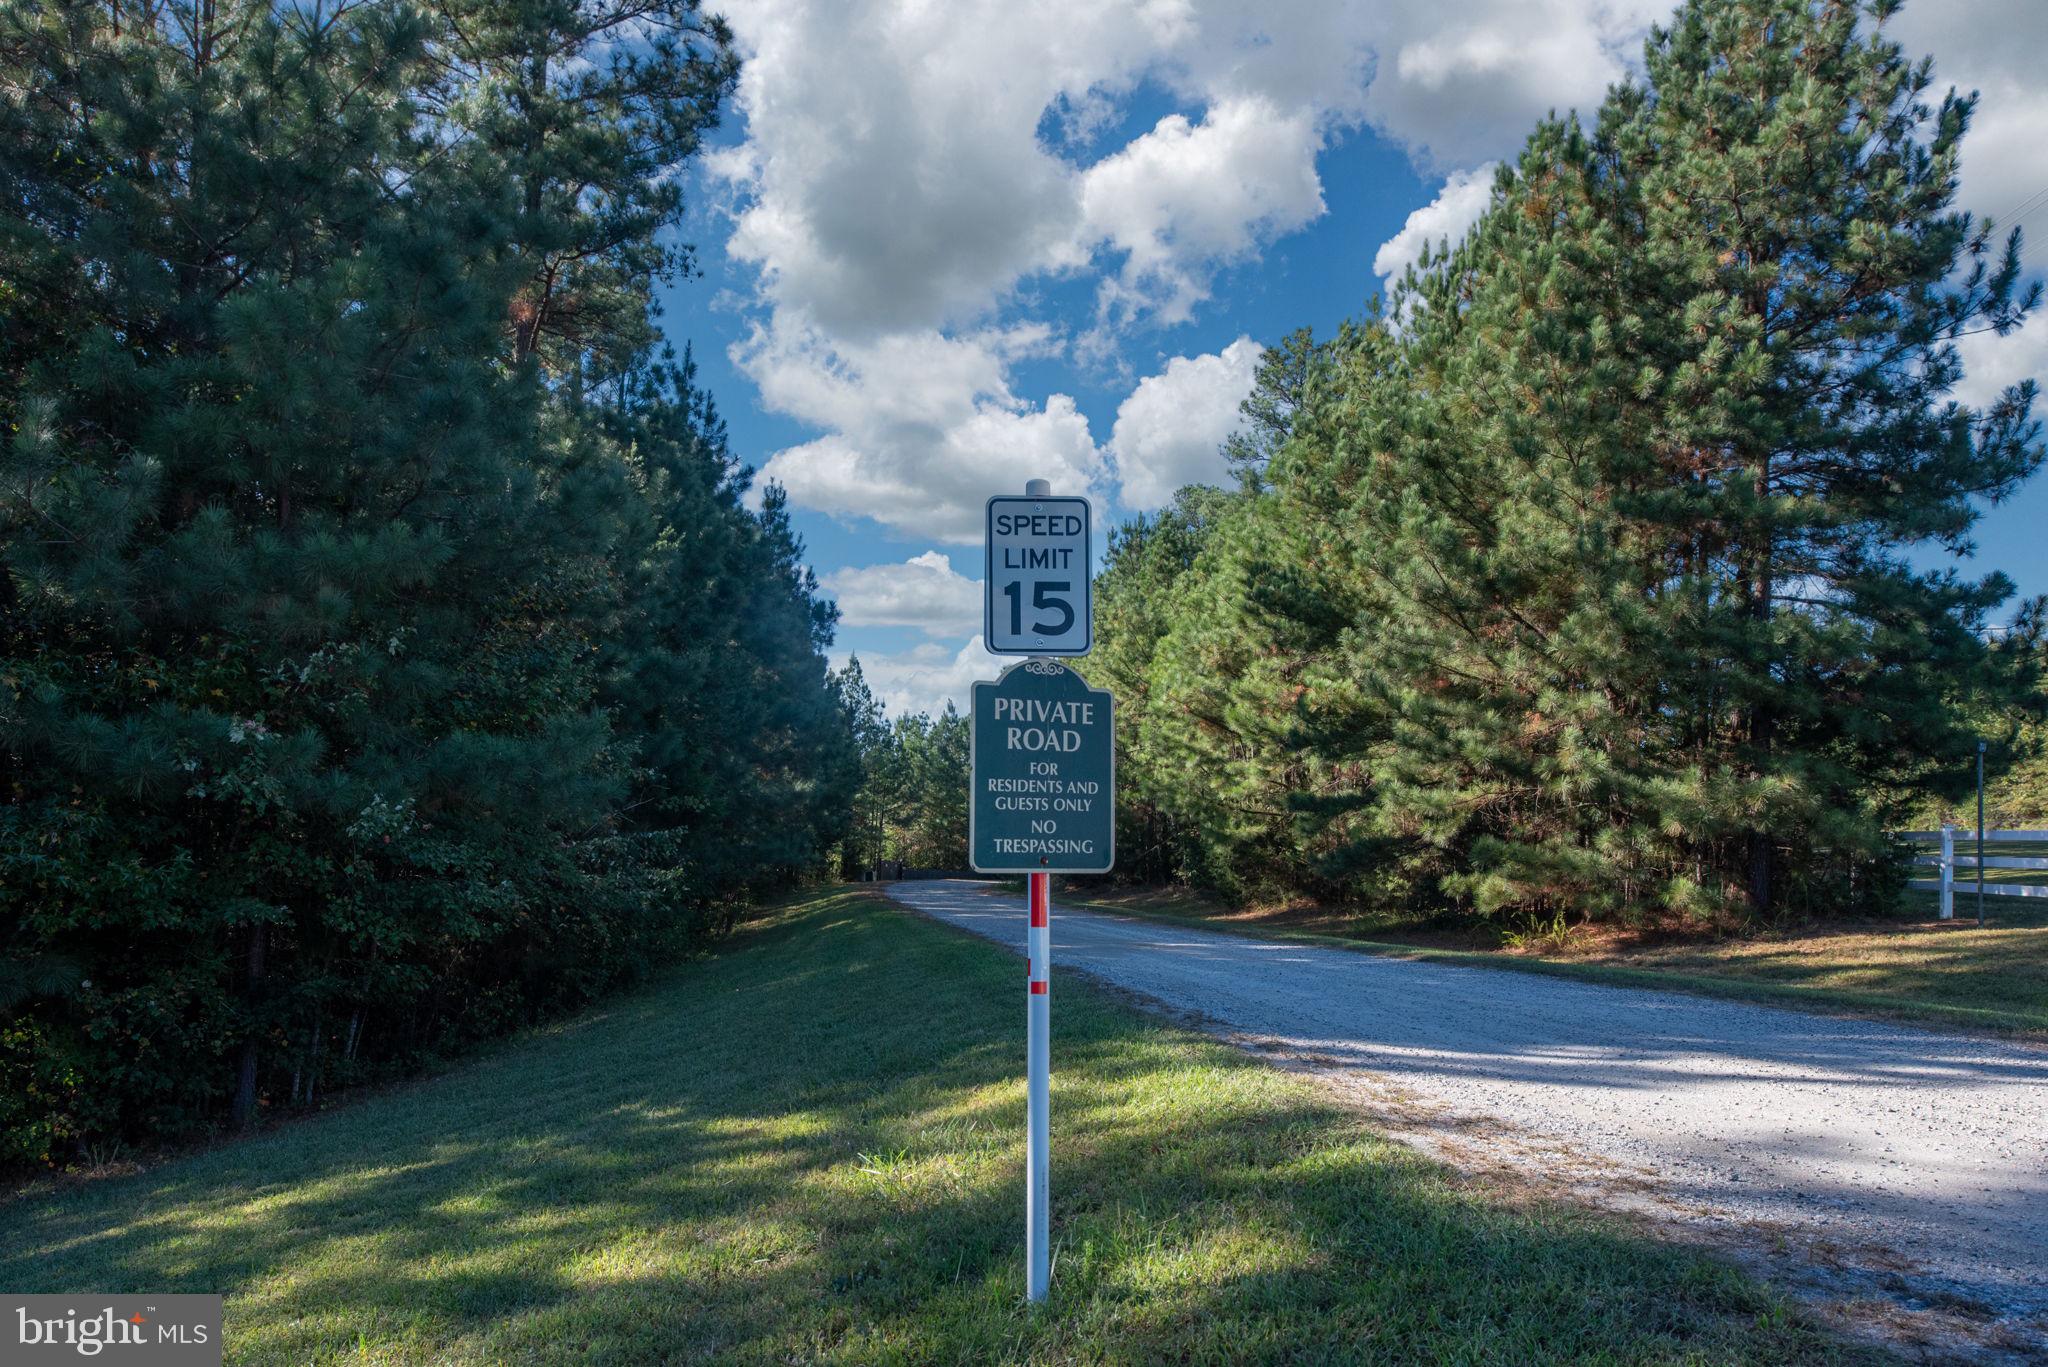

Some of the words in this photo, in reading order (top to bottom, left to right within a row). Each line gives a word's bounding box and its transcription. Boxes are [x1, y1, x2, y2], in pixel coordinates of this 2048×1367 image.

[996, 515, 1082, 536] SPEED
[1005, 548, 1073, 569] LIMIT
[1004, 581, 1075, 636] 15
[994, 697, 1094, 725] PRIVATE
[1007, 727, 1081, 752] ROAD
[1030, 762, 1058, 776] FOR
[988, 778, 1063, 794] RESIDENTS
[1067, 781, 1099, 795] AND
[995, 796, 1049, 811] GUESTS
[1053, 799, 1092, 812] ONLY
[1031, 819, 1057, 834] NO
[993, 838, 1093, 854] TRESPASSING
